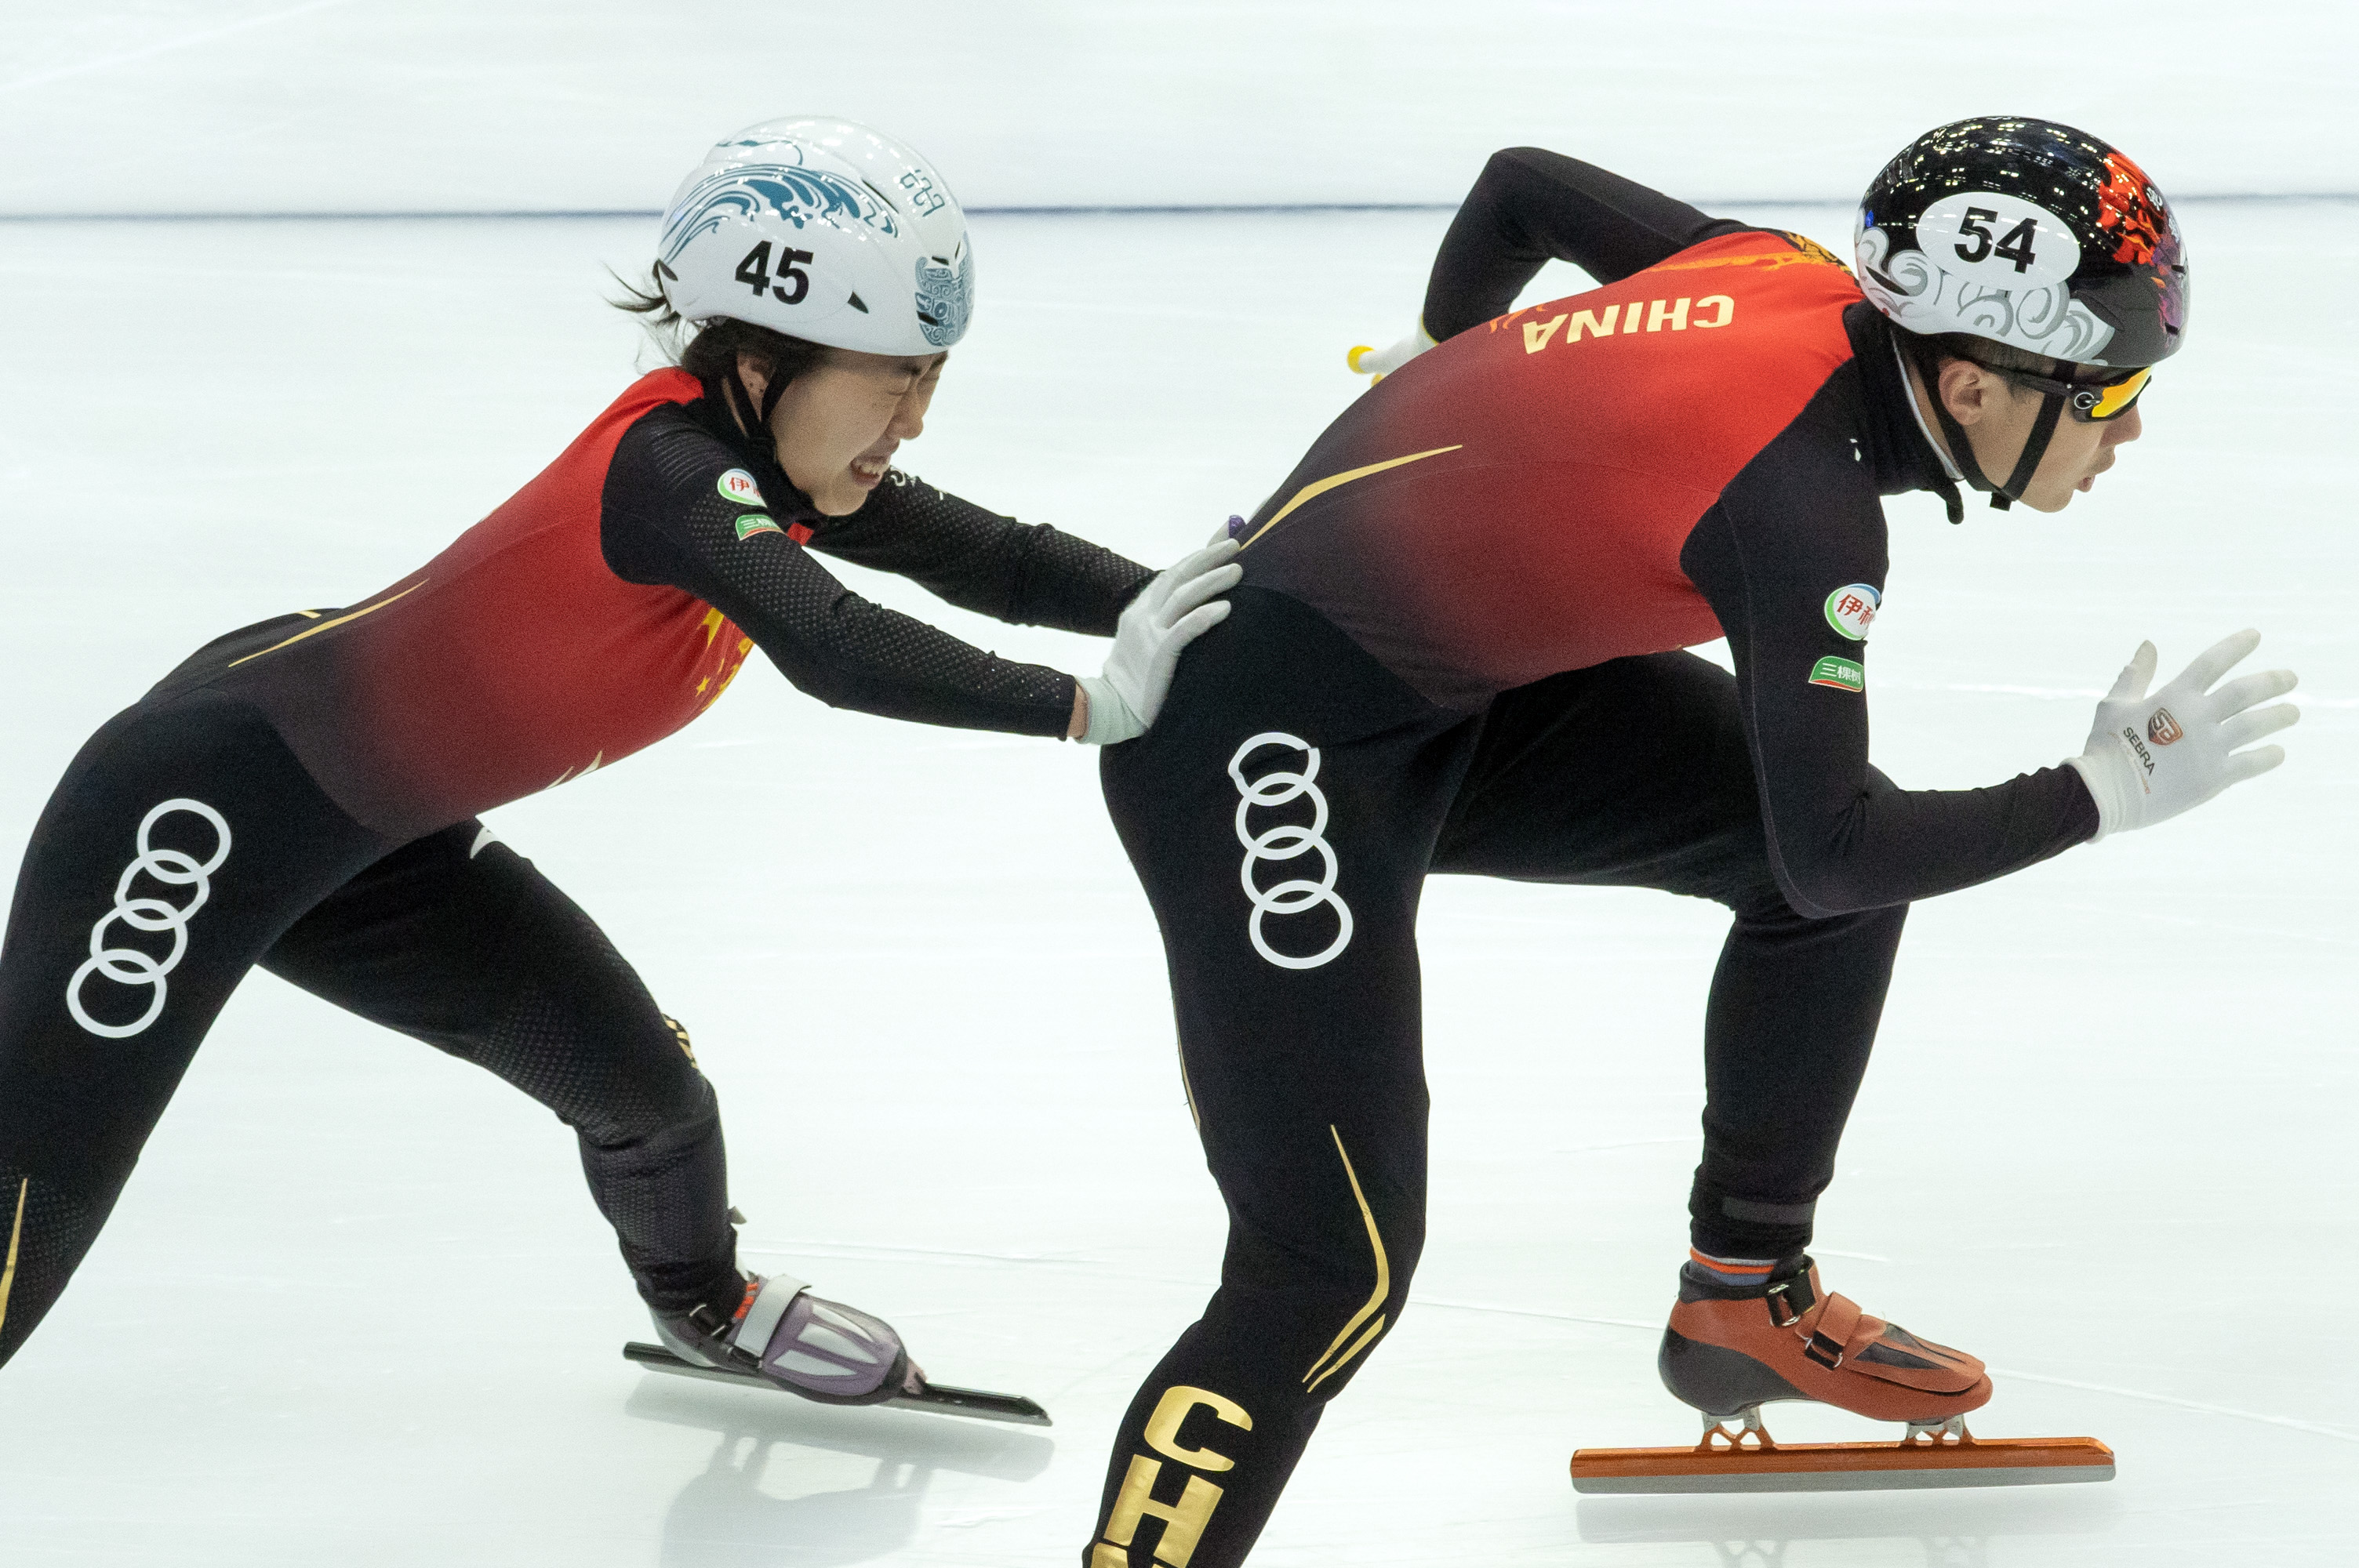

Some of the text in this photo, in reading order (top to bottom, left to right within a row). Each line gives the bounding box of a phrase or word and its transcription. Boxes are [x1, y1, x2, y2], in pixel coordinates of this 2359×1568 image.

[734, 240, 814, 306] 45
[1954, 206, 2038, 274] 54
[1521, 295, 1735, 354] CHINA
[2123, 727, 2155, 775] SEBRA
[1090, 1385, 1253, 1568] CH
